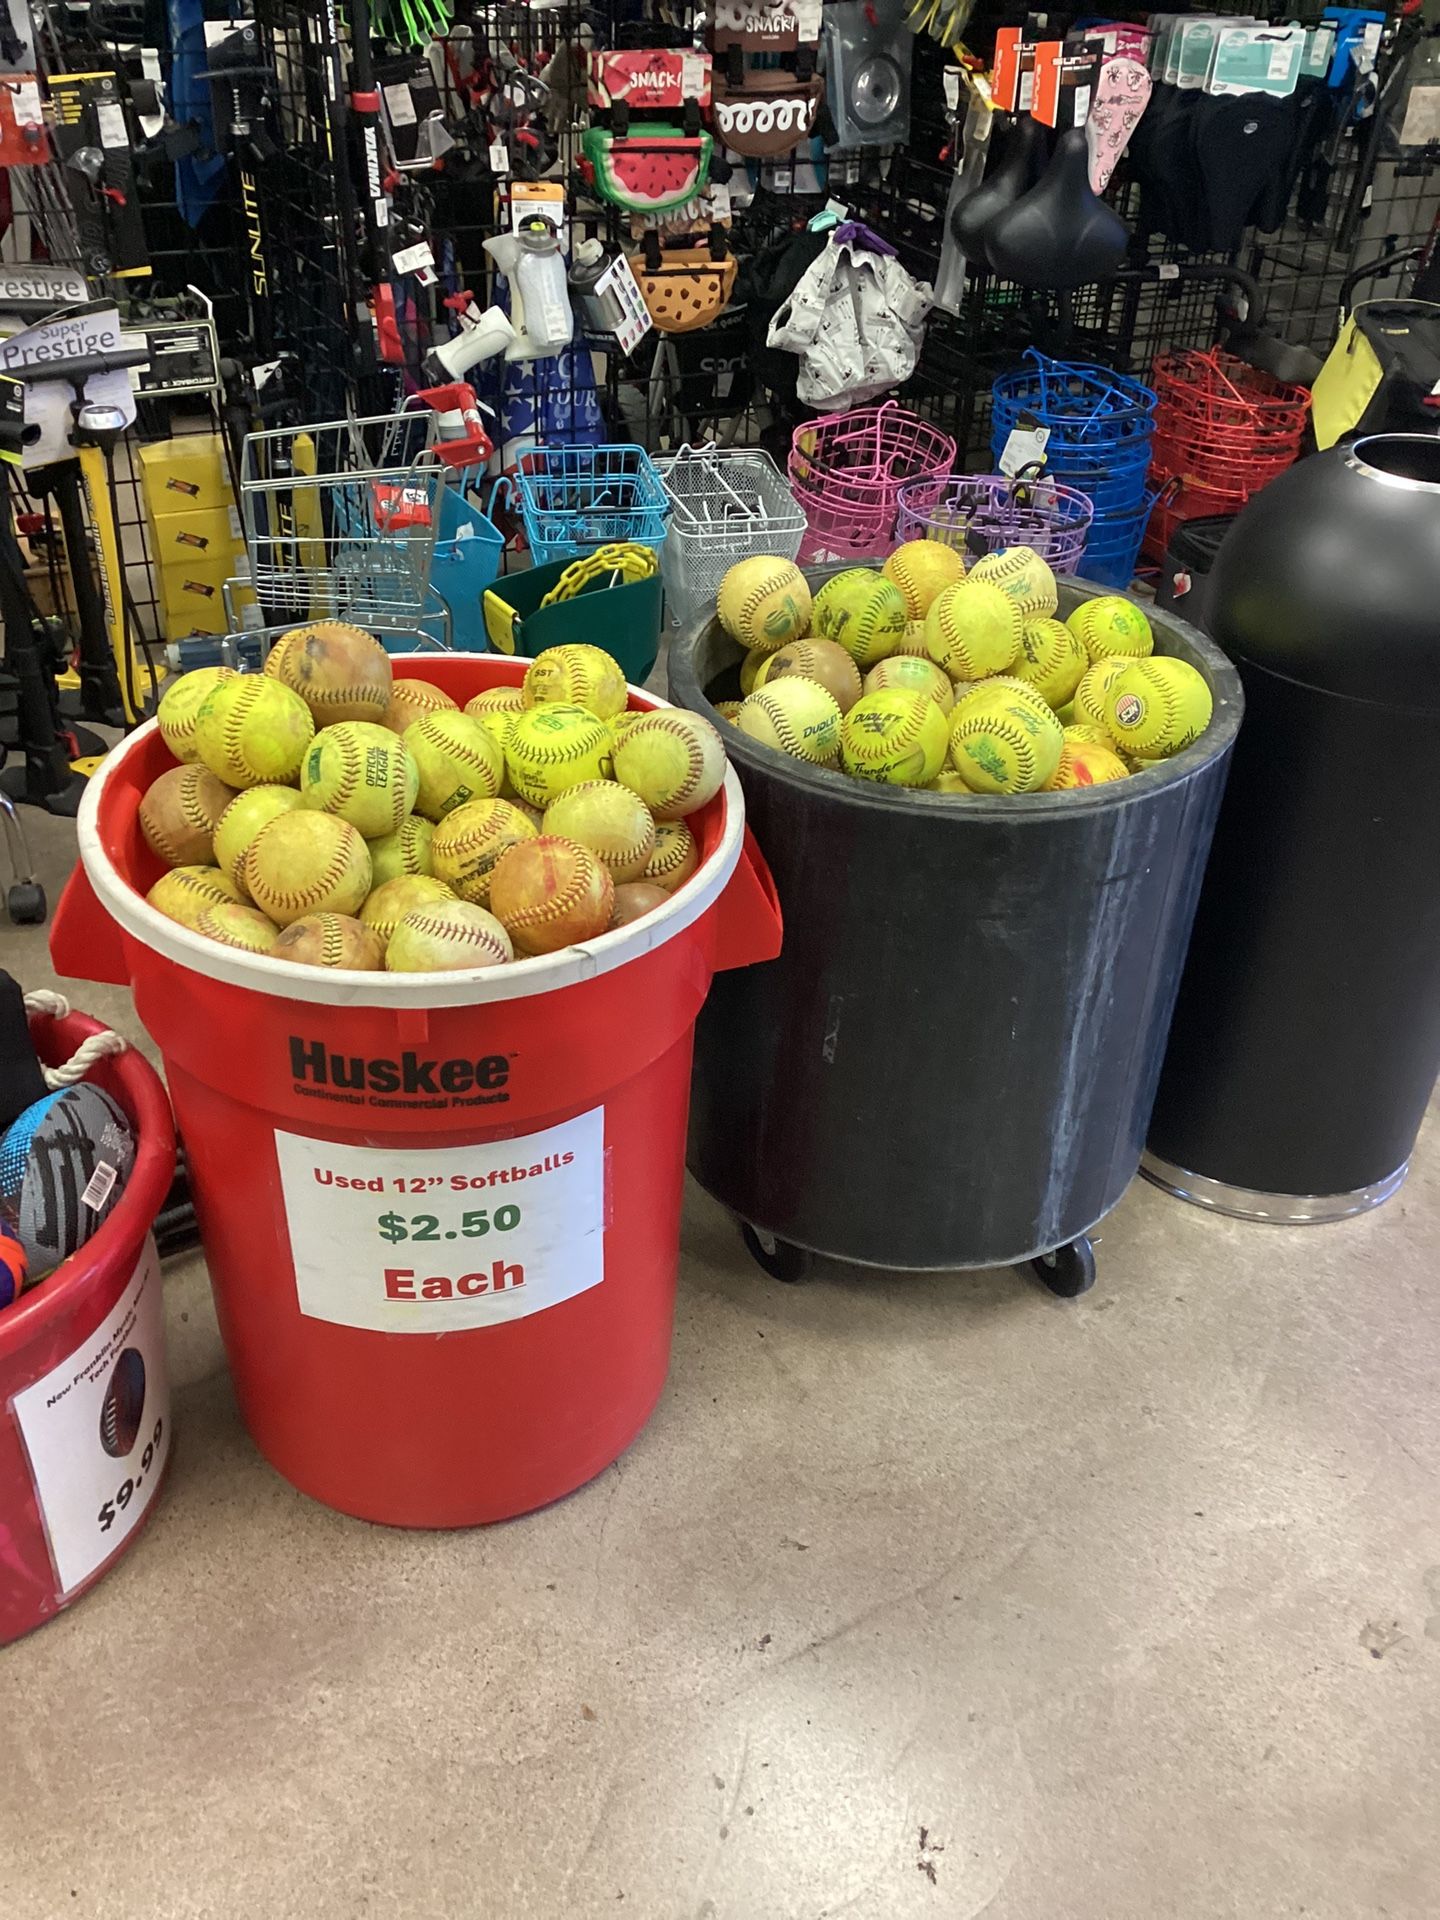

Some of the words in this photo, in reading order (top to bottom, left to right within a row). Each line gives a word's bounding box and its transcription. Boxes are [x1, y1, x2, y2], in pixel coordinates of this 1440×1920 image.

[745, 14, 796, 33] SNACK!
[630, 71, 682, 88] SNACK!
[363, 126, 382, 198] YAKIMA
[240, 170, 269, 298] SUNLITE
[2, 331, 115, 369] Prestige
[40, 319, 88, 341] Super
[365, 746, 377, 788] OFFICIAL
[377, 747, 389, 789] LEAGUE
[854, 760, 902, 776] Thunder
[288, 1035, 510, 1095] Huskee
[293, 1083, 365, 1106] Continental
[369, 1096, 449, 1110] Commercial
[452, 1091, 510, 1108] Products
[313, 1167, 384, 1193] Used
[450, 1151, 575, 1191] Softballs
[377, 1203, 522, 1245] $2.50
[383, 1260, 525, 1300] Each
[46, 1384, 71, 1408] New
[73, 1341, 112, 1385] Franklin
[97, 1416, 163, 1532] $9.99
